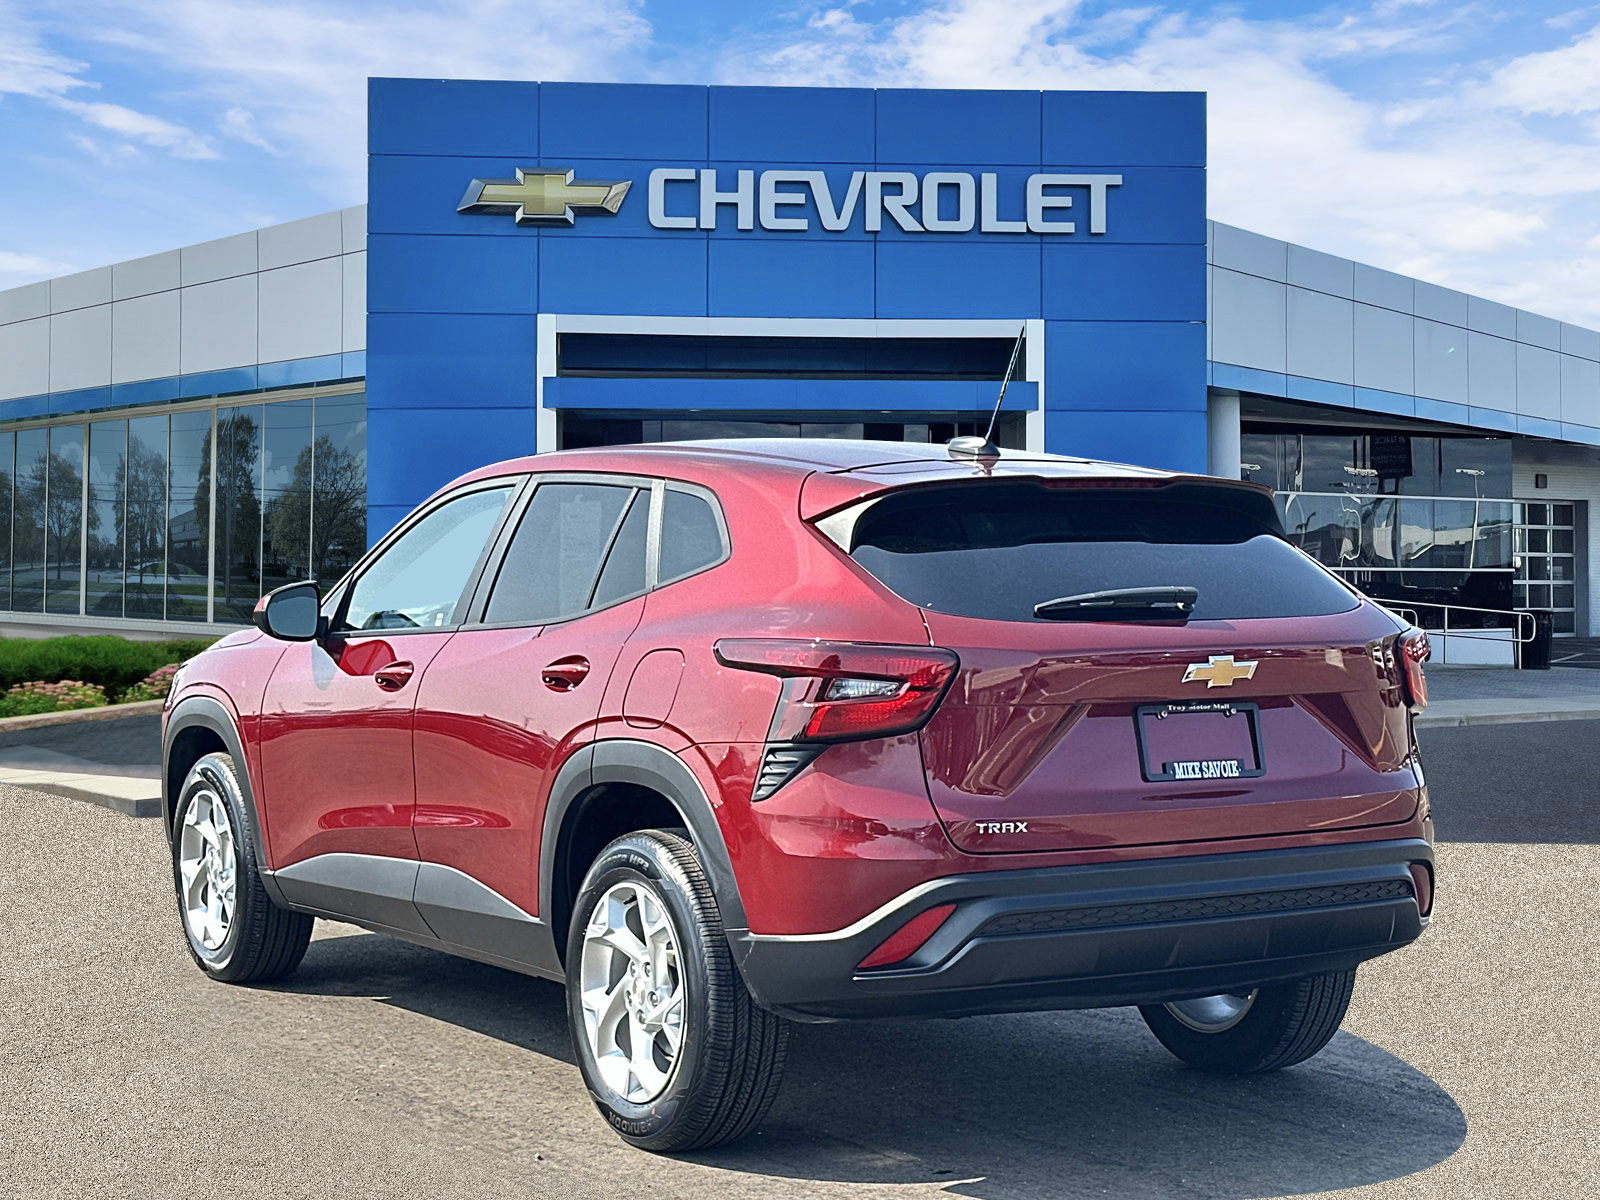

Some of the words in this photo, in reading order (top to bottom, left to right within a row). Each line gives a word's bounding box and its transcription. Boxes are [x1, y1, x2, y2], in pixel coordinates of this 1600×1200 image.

[648, 168, 1123, 234] CHEVROLET
[1167, 704, 1186, 712] Troy
[1173, 761, 1201, 779] MIKE
[1202, 760, 1240, 778] SAVOIE
[975, 821, 1028, 834] TRAX
